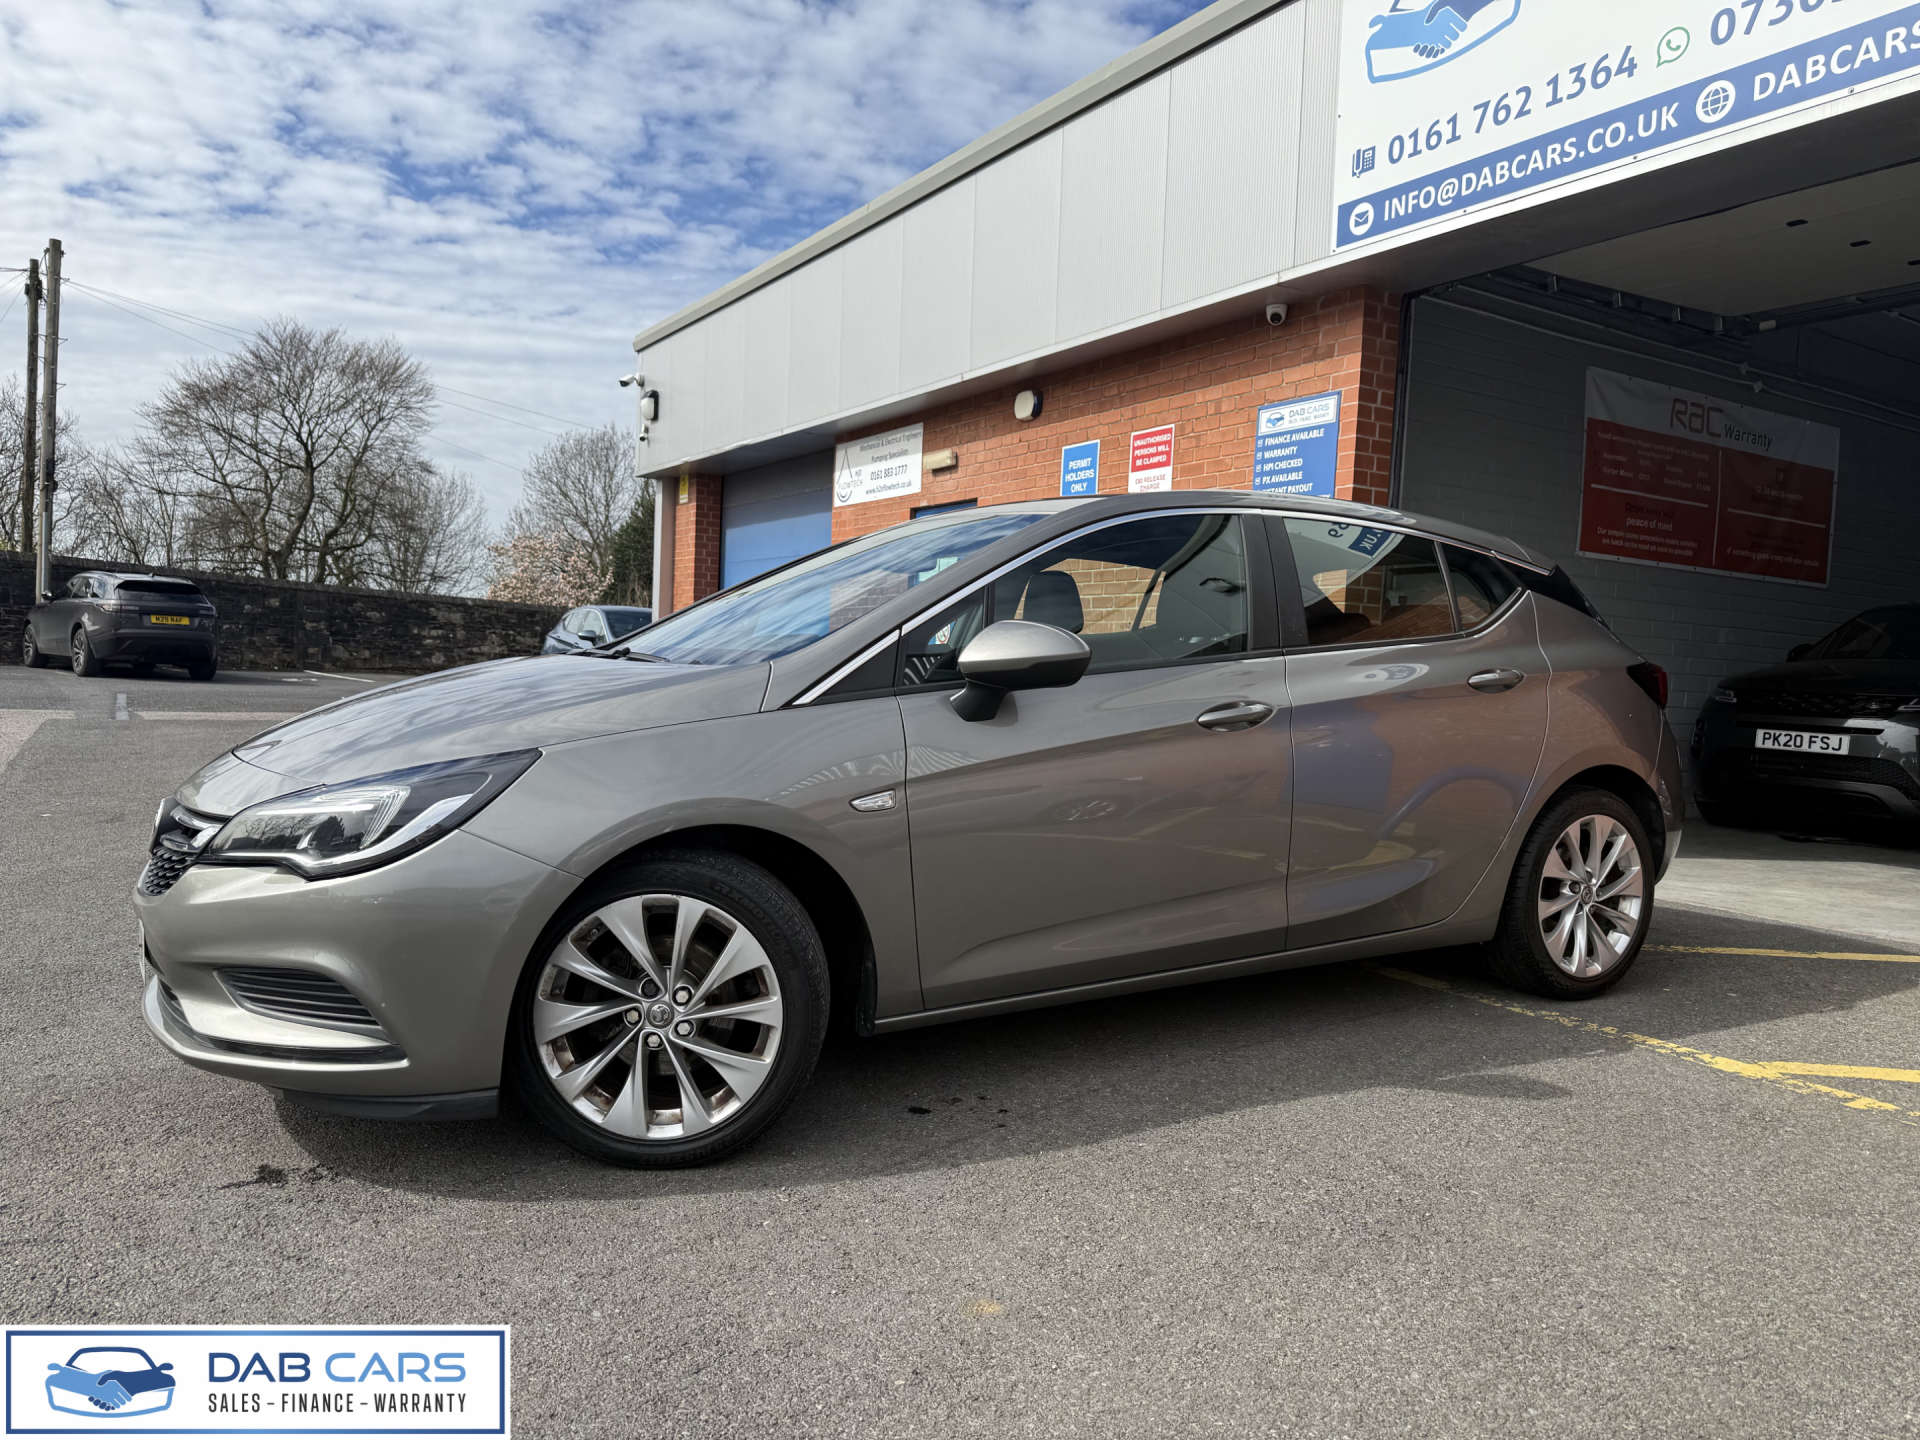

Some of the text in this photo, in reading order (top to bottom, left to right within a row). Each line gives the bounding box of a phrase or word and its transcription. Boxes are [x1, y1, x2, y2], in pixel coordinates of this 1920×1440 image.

[1388, 0, 1844, 164] 0161 762 1364 073
[1383, 102, 1680, 221] INFO@DABCARS.CO.UK
[1289, 408, 1305, 418] DAB
[1134, 433, 1171, 447] UNAUTHORISED
[1265, 428, 1325, 446] FINANCE AVAILABLE
[1723, 423, 1773, 451] Warranty
[1134, 444, 1169, 457] PERSONS WILL
[1264, 446, 1298, 459] WARRANTY
[1068, 457, 1092, 470] PERMIT
[1135, 454, 1167, 467] BE CLAMPED
[1274, 458, 1303, 469] CHECKED
[1065, 469, 1095, 483] HOLDERS
[1271, 471, 1303, 483] AVAILABLE
[1070, 482, 1087, 493] ONLY
[1287, 483, 1313, 493] PAYOUT
[1762, 732, 1843, 751] PK20 FSJ
